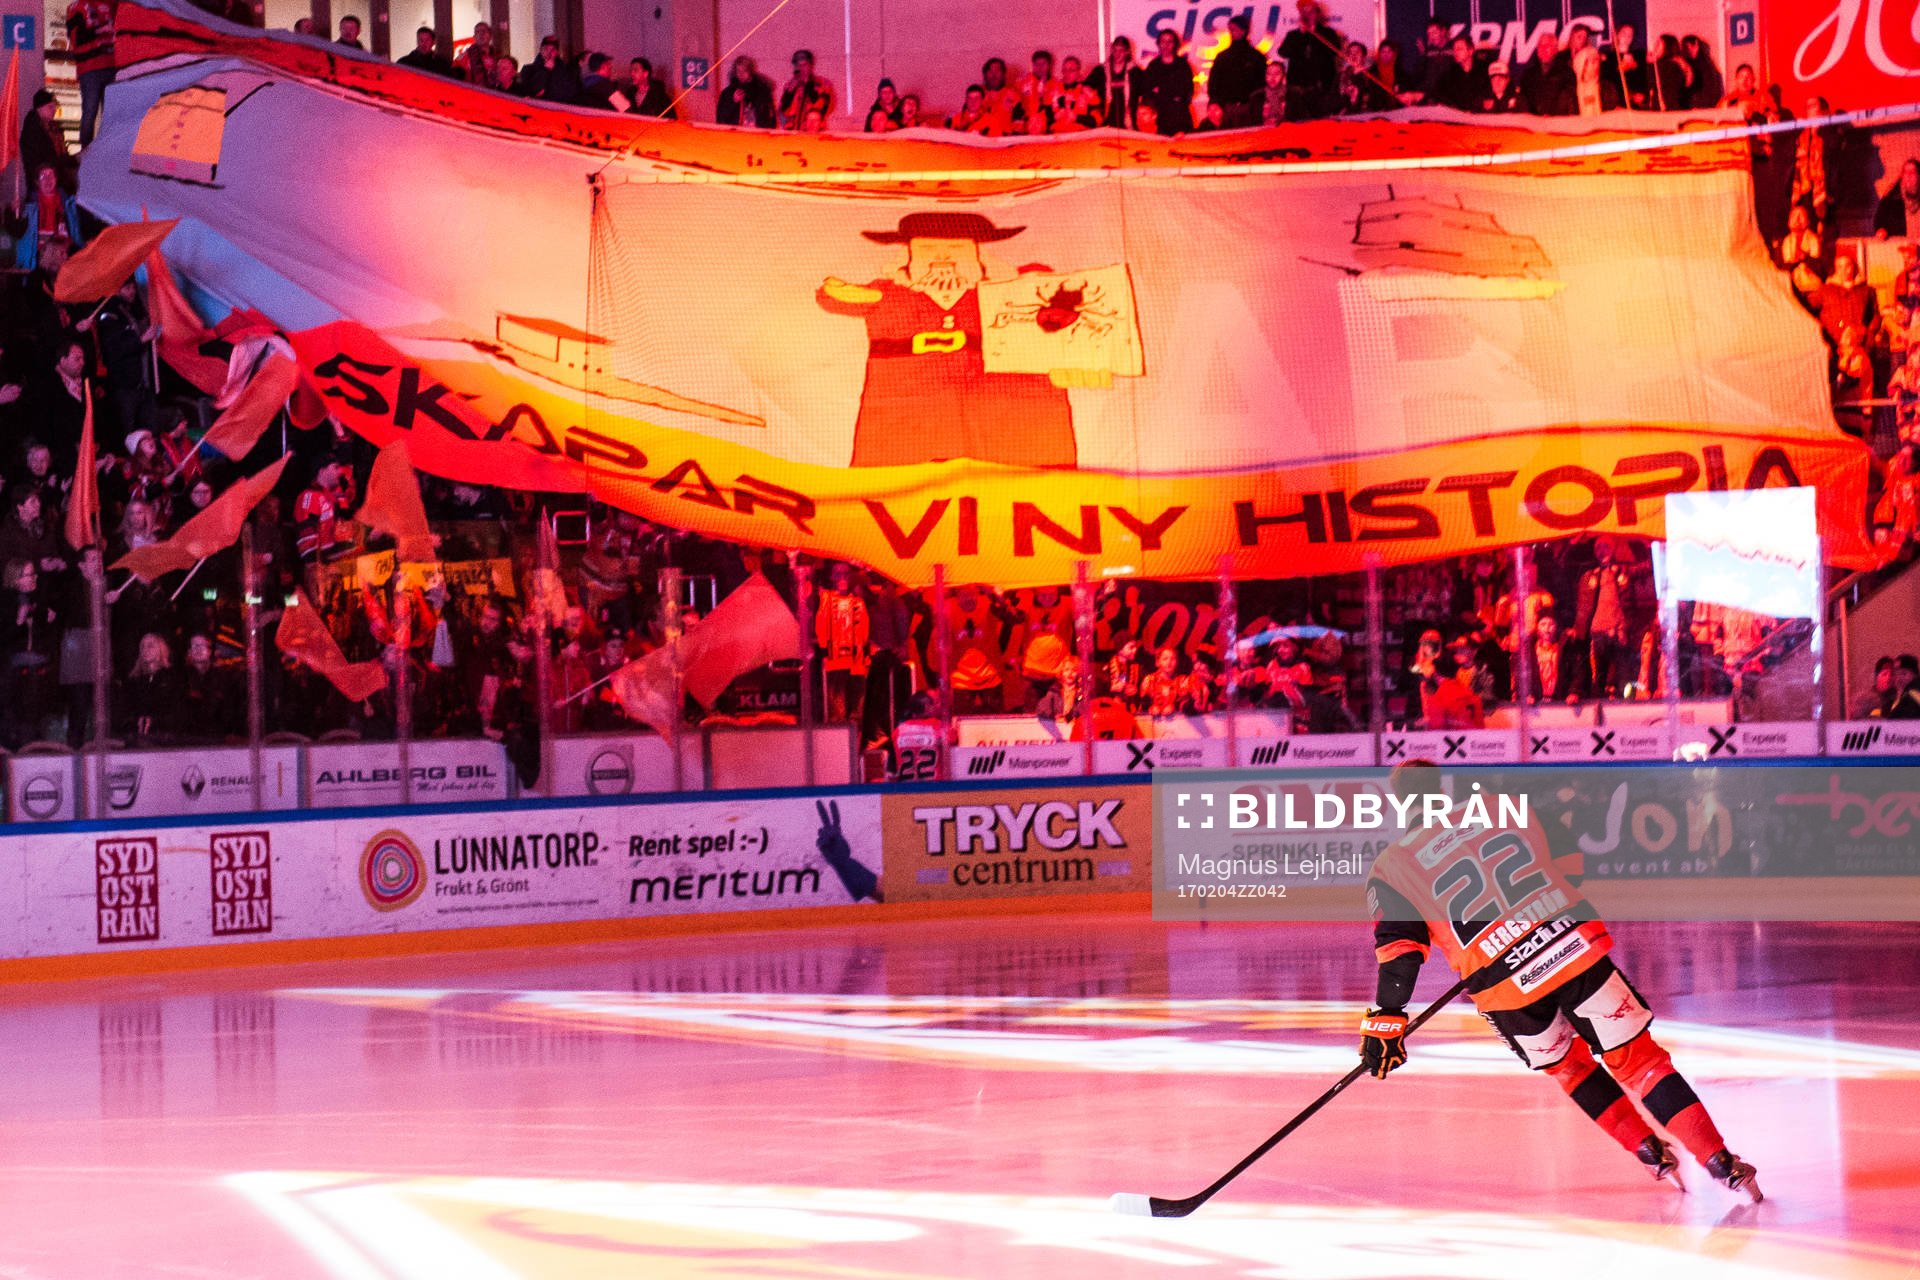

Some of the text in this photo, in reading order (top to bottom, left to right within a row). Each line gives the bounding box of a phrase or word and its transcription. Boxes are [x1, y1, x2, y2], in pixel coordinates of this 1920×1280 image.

[13, 22, 26, 43] C
[1736, 20, 1748, 40] D
[314, 353, 816, 535] SKAPAR
[865, 496, 980, 560] VI
[1012, 501, 1188, 556] NY
[900, 748, 937, 781] 22
[1008, 755, 1071, 771] Manpower
[1293, 745, 1360, 760] Manpower
[456, 764, 497, 779] BIL
[629, 834, 682, 857] Rent
[687, 829, 735, 857] spel
[913, 800, 1127, 856] TRYCK
[99, 841, 155, 876] SYD
[213, 836, 267, 870] SYD
[1597, 857, 1670, 875] event
[216, 867, 268, 900] OST
[630, 868, 820, 904] meritum
[953, 857, 1094, 886] centrum
[101, 875, 155, 907] OST
[435, 881, 472, 896] Frukt
[1433, 832, 1552, 950] 22
[100, 906, 157, 938] RAN
[215, 899, 269, 931] RAN
[1504, 914, 1578, 971] stadium
